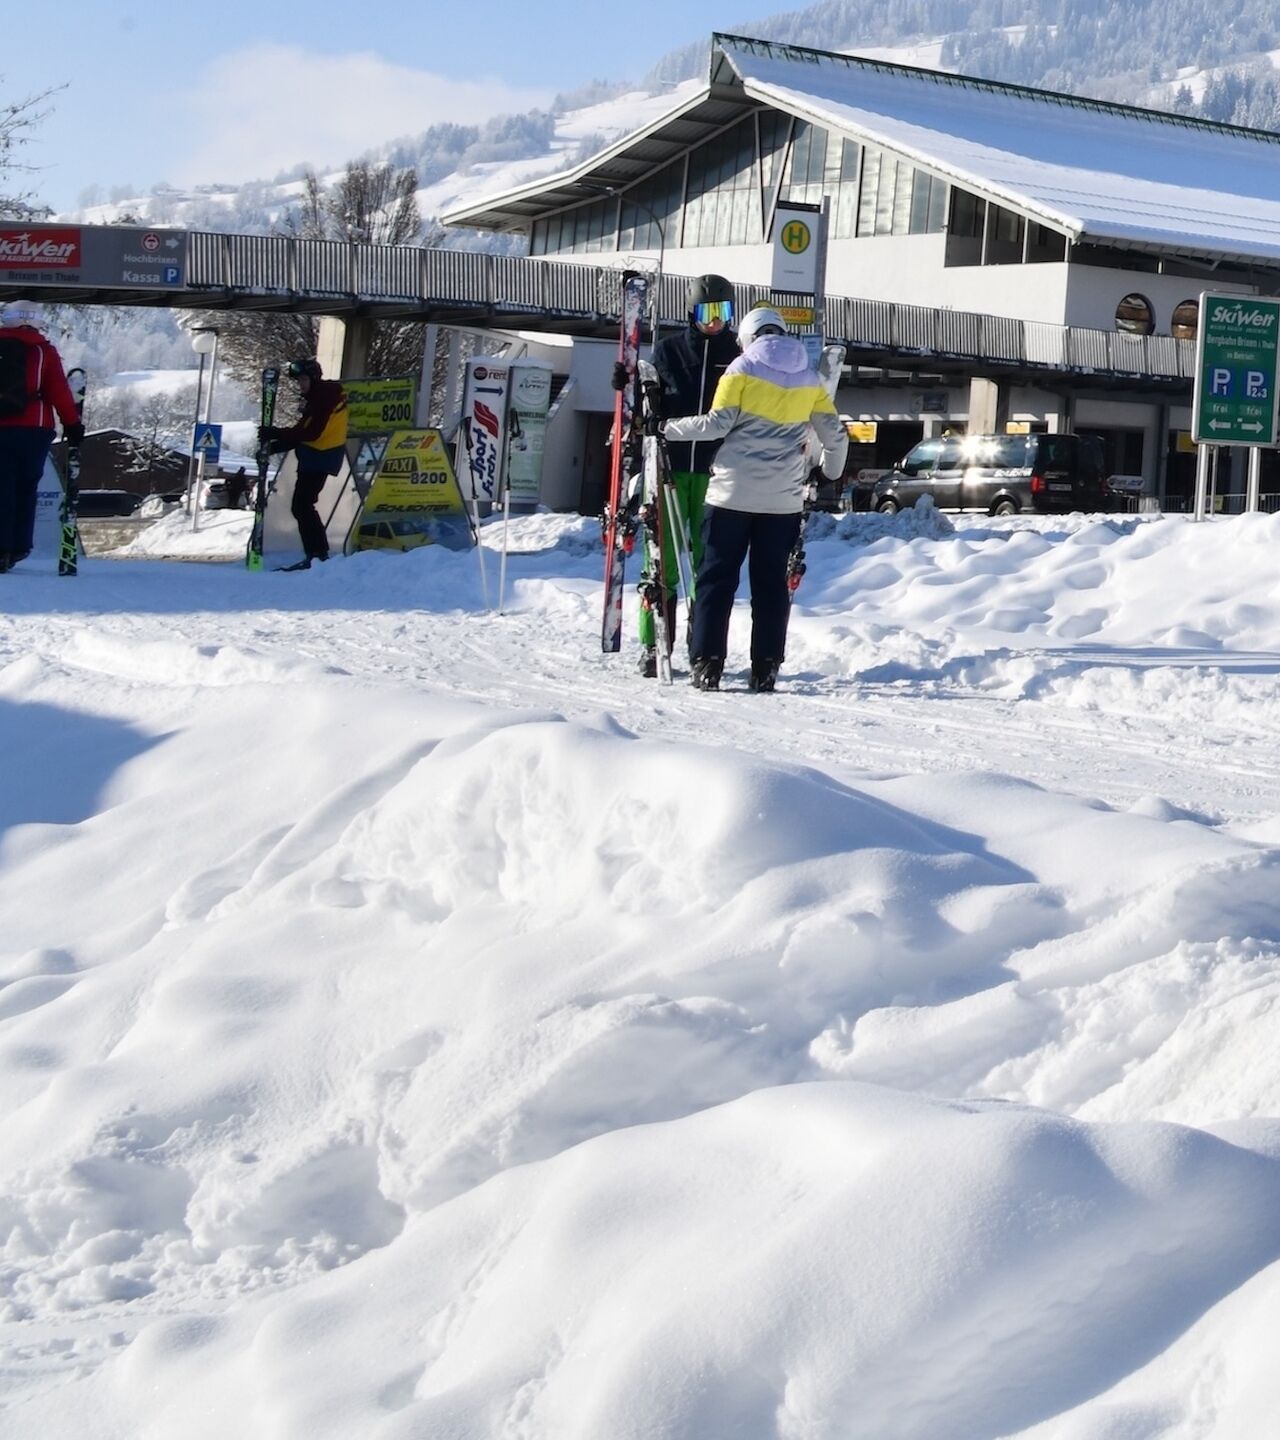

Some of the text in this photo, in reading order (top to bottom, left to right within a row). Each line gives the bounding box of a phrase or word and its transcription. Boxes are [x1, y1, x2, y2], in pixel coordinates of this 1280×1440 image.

[788, 226, 803, 248] H
[123, 269, 177, 283] Kassa P
[1211, 305, 1275, 327] SkiWelt
[382, 403, 411, 422] 8200
[386, 458, 413, 472] TAXI
[411, 472, 447, 484] 8200
